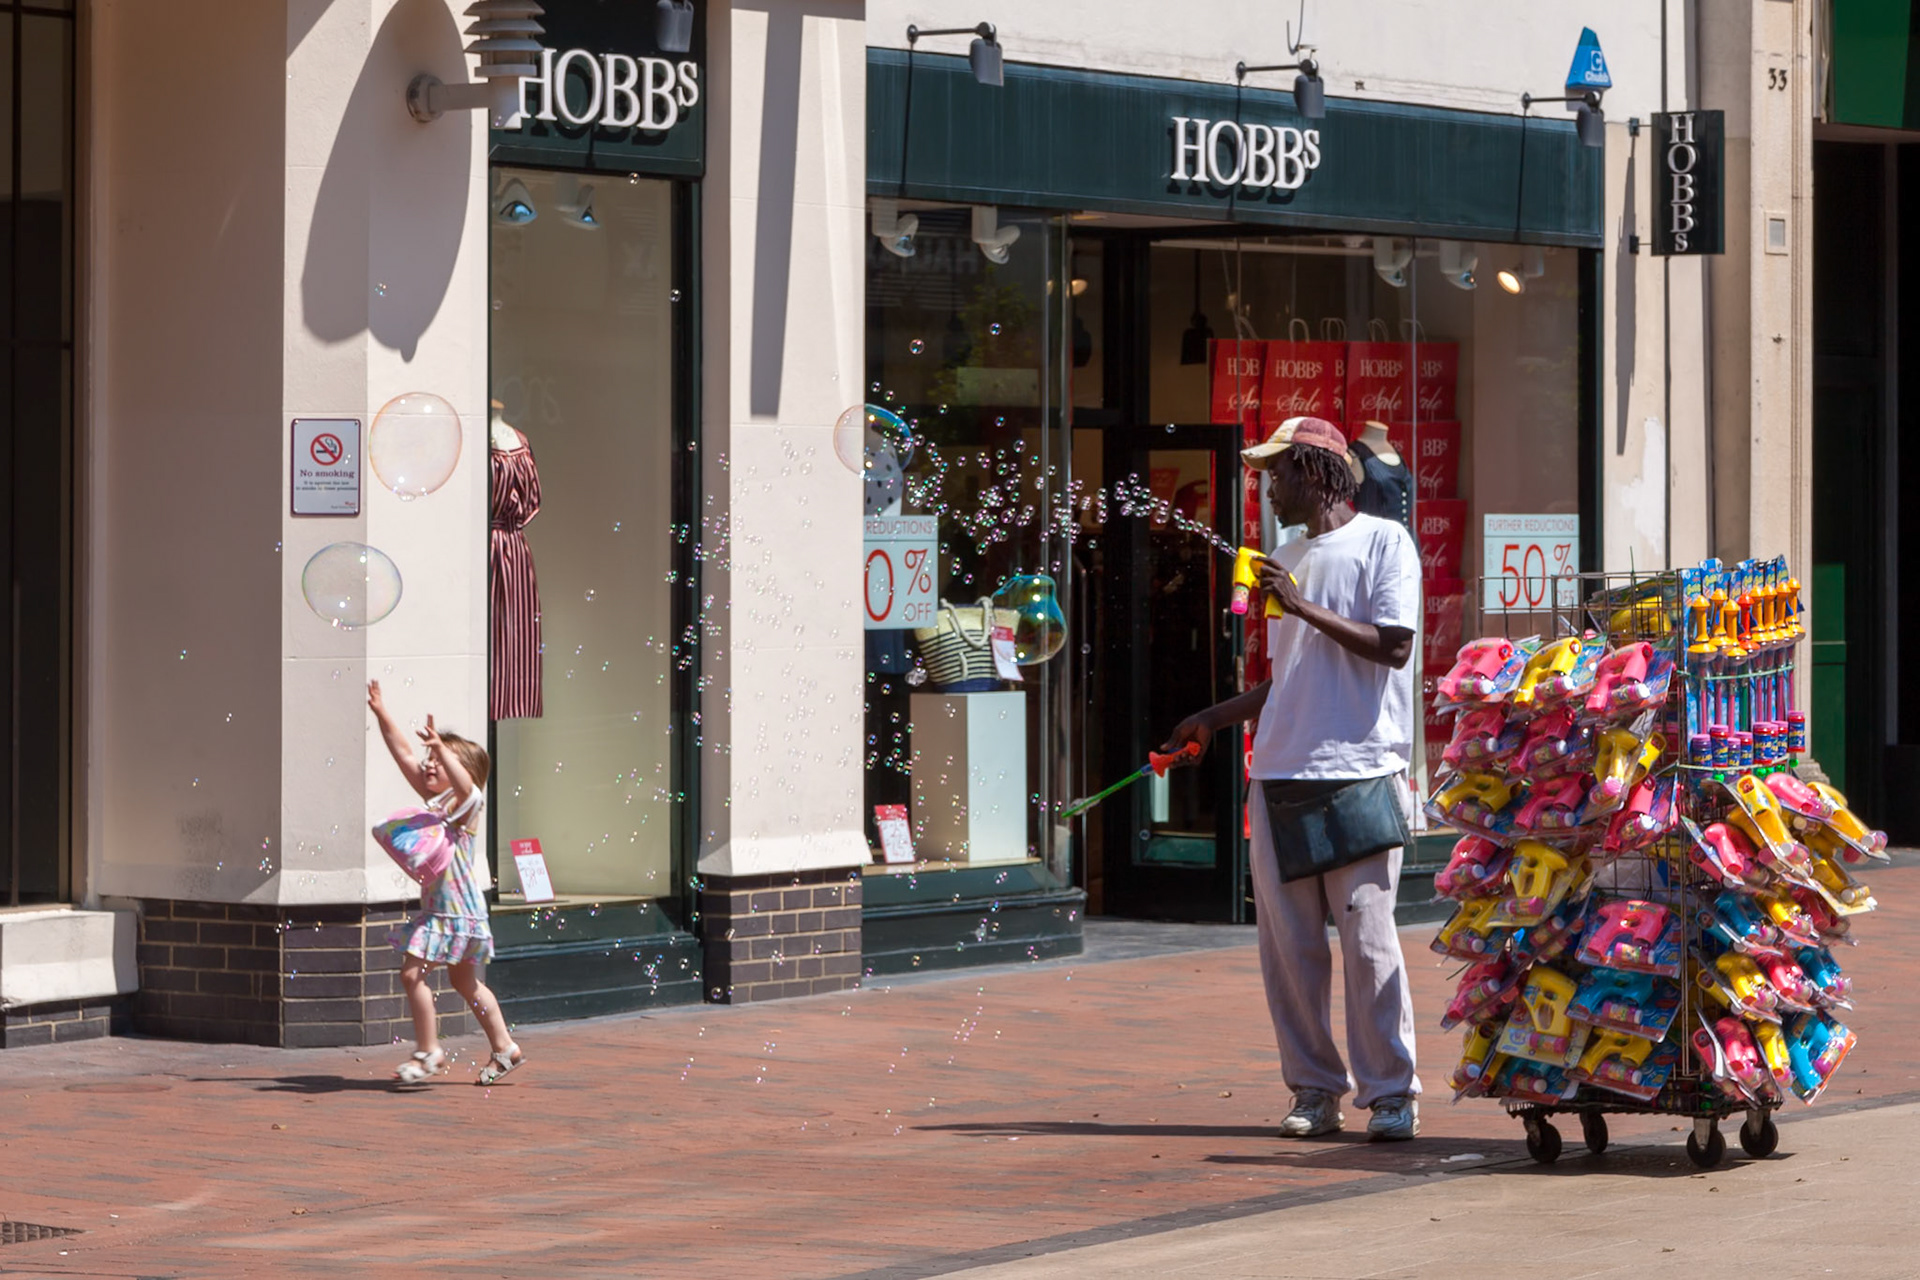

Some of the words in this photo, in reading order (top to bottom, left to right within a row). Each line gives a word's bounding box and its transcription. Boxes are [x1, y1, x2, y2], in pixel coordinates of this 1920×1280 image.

[1768, 68, 1787, 91] 33
[300, 469, 313, 477] No
[315, 469, 355, 479] smoking
[866, 521, 933, 535] REDUCTIONS
[1524, 519, 1575, 532] REDUCTIONS
[904, 603, 932, 622] OFF
